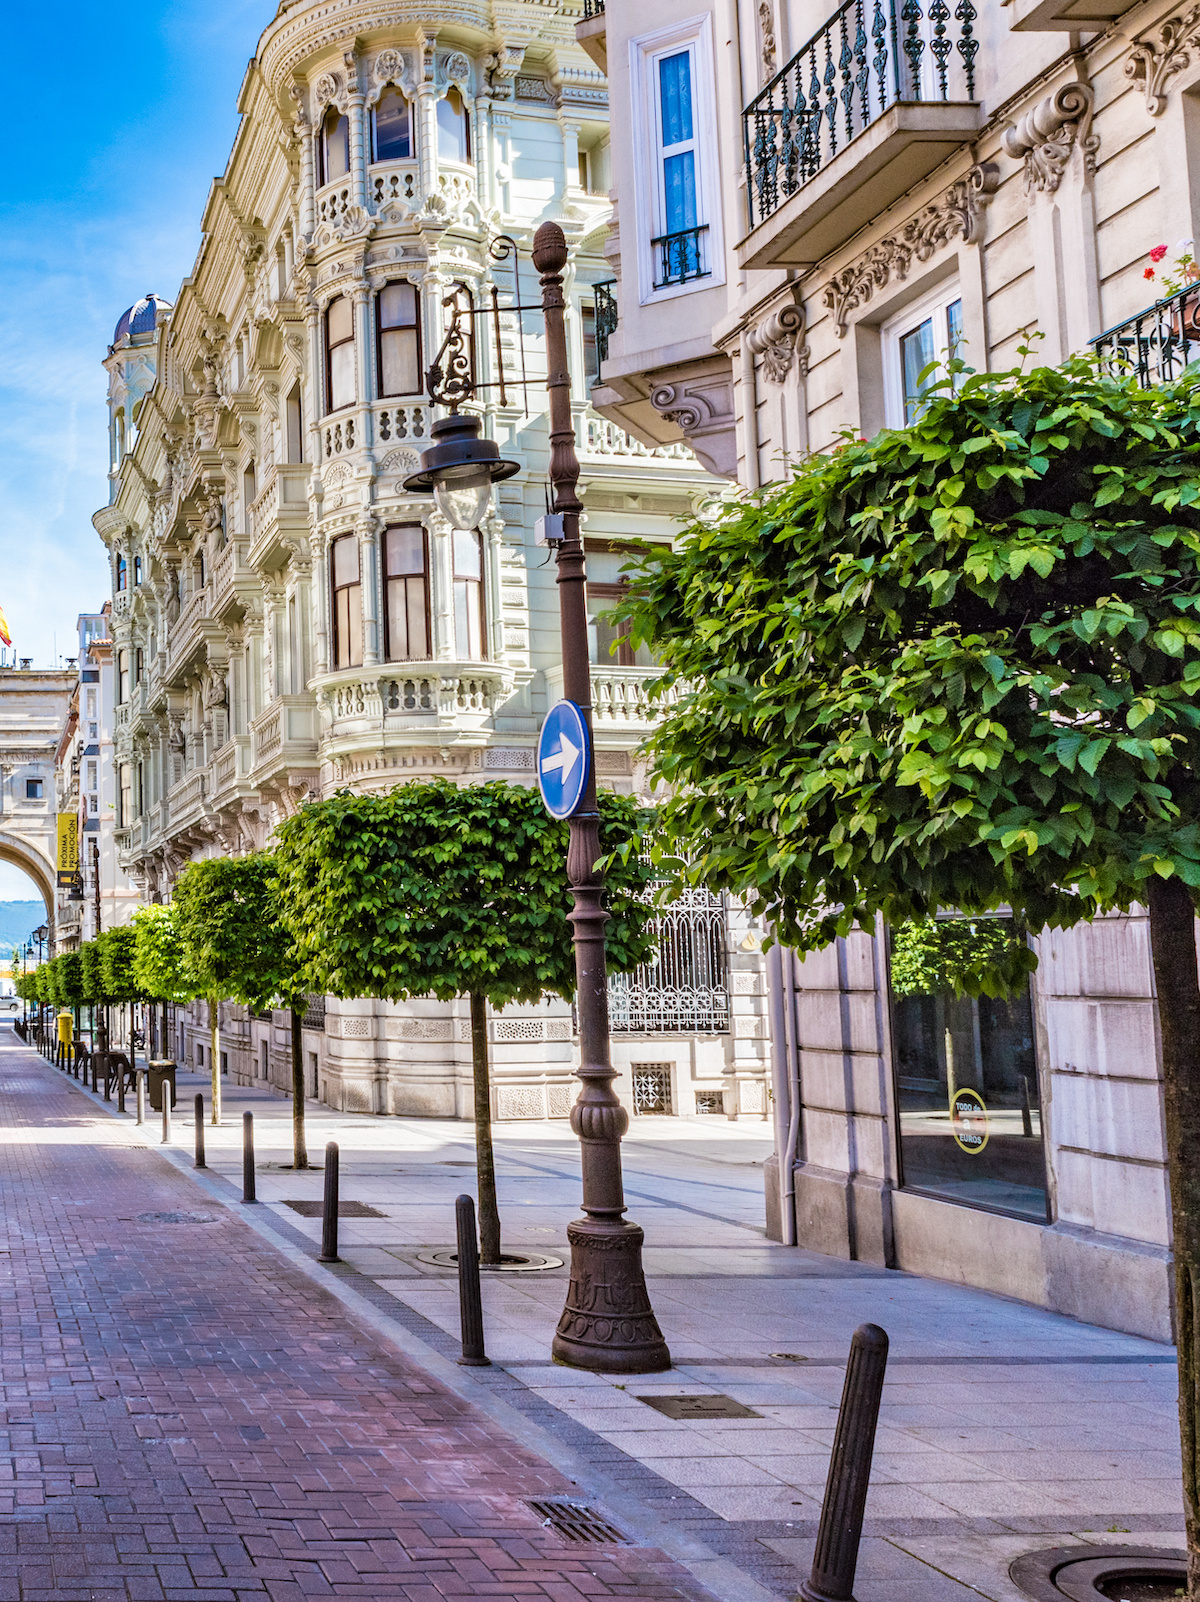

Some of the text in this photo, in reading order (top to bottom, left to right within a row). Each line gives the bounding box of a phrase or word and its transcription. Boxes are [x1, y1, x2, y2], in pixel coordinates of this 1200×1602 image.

[68, 819, 76, 868] PROMOCIÓN
[956, 1102, 972, 1111] TODO
[959, 1133, 982, 1145] EUROS
